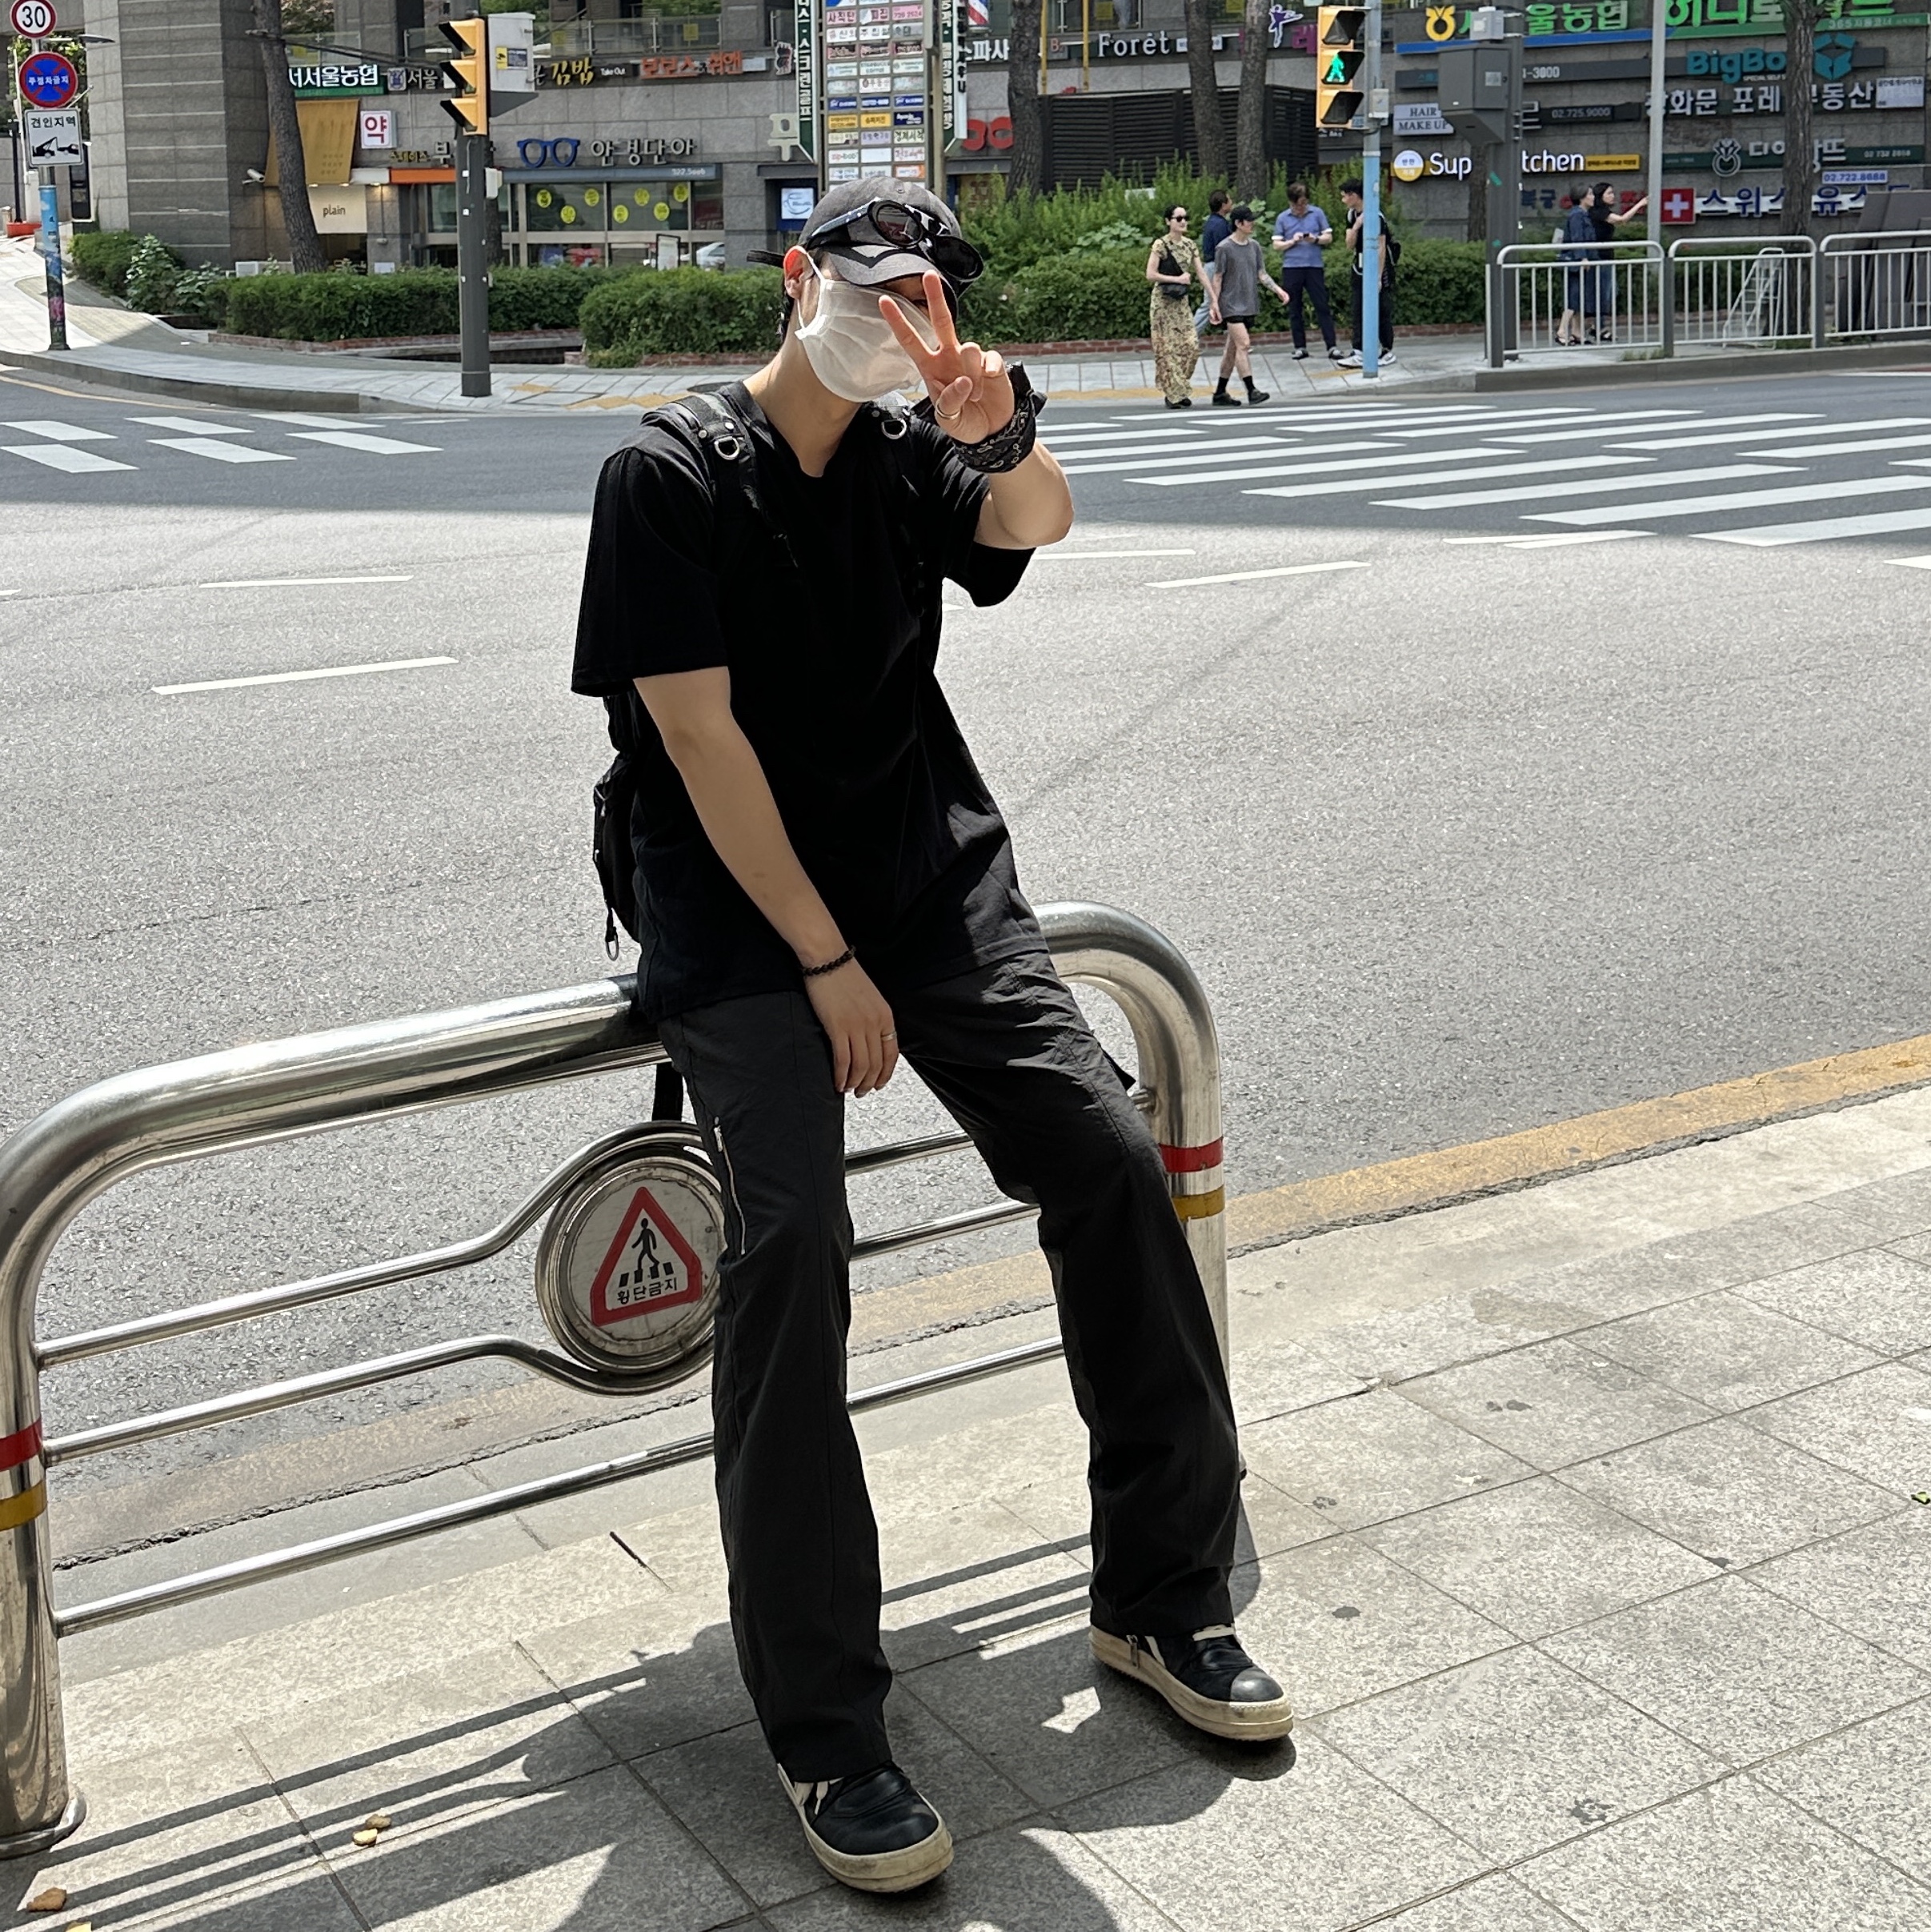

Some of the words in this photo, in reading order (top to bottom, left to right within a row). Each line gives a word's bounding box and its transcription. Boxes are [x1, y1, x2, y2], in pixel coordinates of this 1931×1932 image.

[22, 6, 46, 28] 30
[1098, 30, 1170, 57] Forêt
[28, 75, 70, 86] 주정차금지
[551, 57, 595, 86] 김밥
[1732, 86, 1781, 113] 포레
[30, 116, 76, 128] 견인지역
[1409, 107, 1437, 117] HAIR
[1552, 107, 1611, 118] 02.725.9000
[365, 116, 387, 144] 약
[1398, 121, 1432, 130] MAKE
[1429, 151, 1472, 181] Sup
[1521, 150, 1584, 173] tchen
[323, 204, 346, 218] plain
[617, 1277, 678, 1305] 횡단금지
